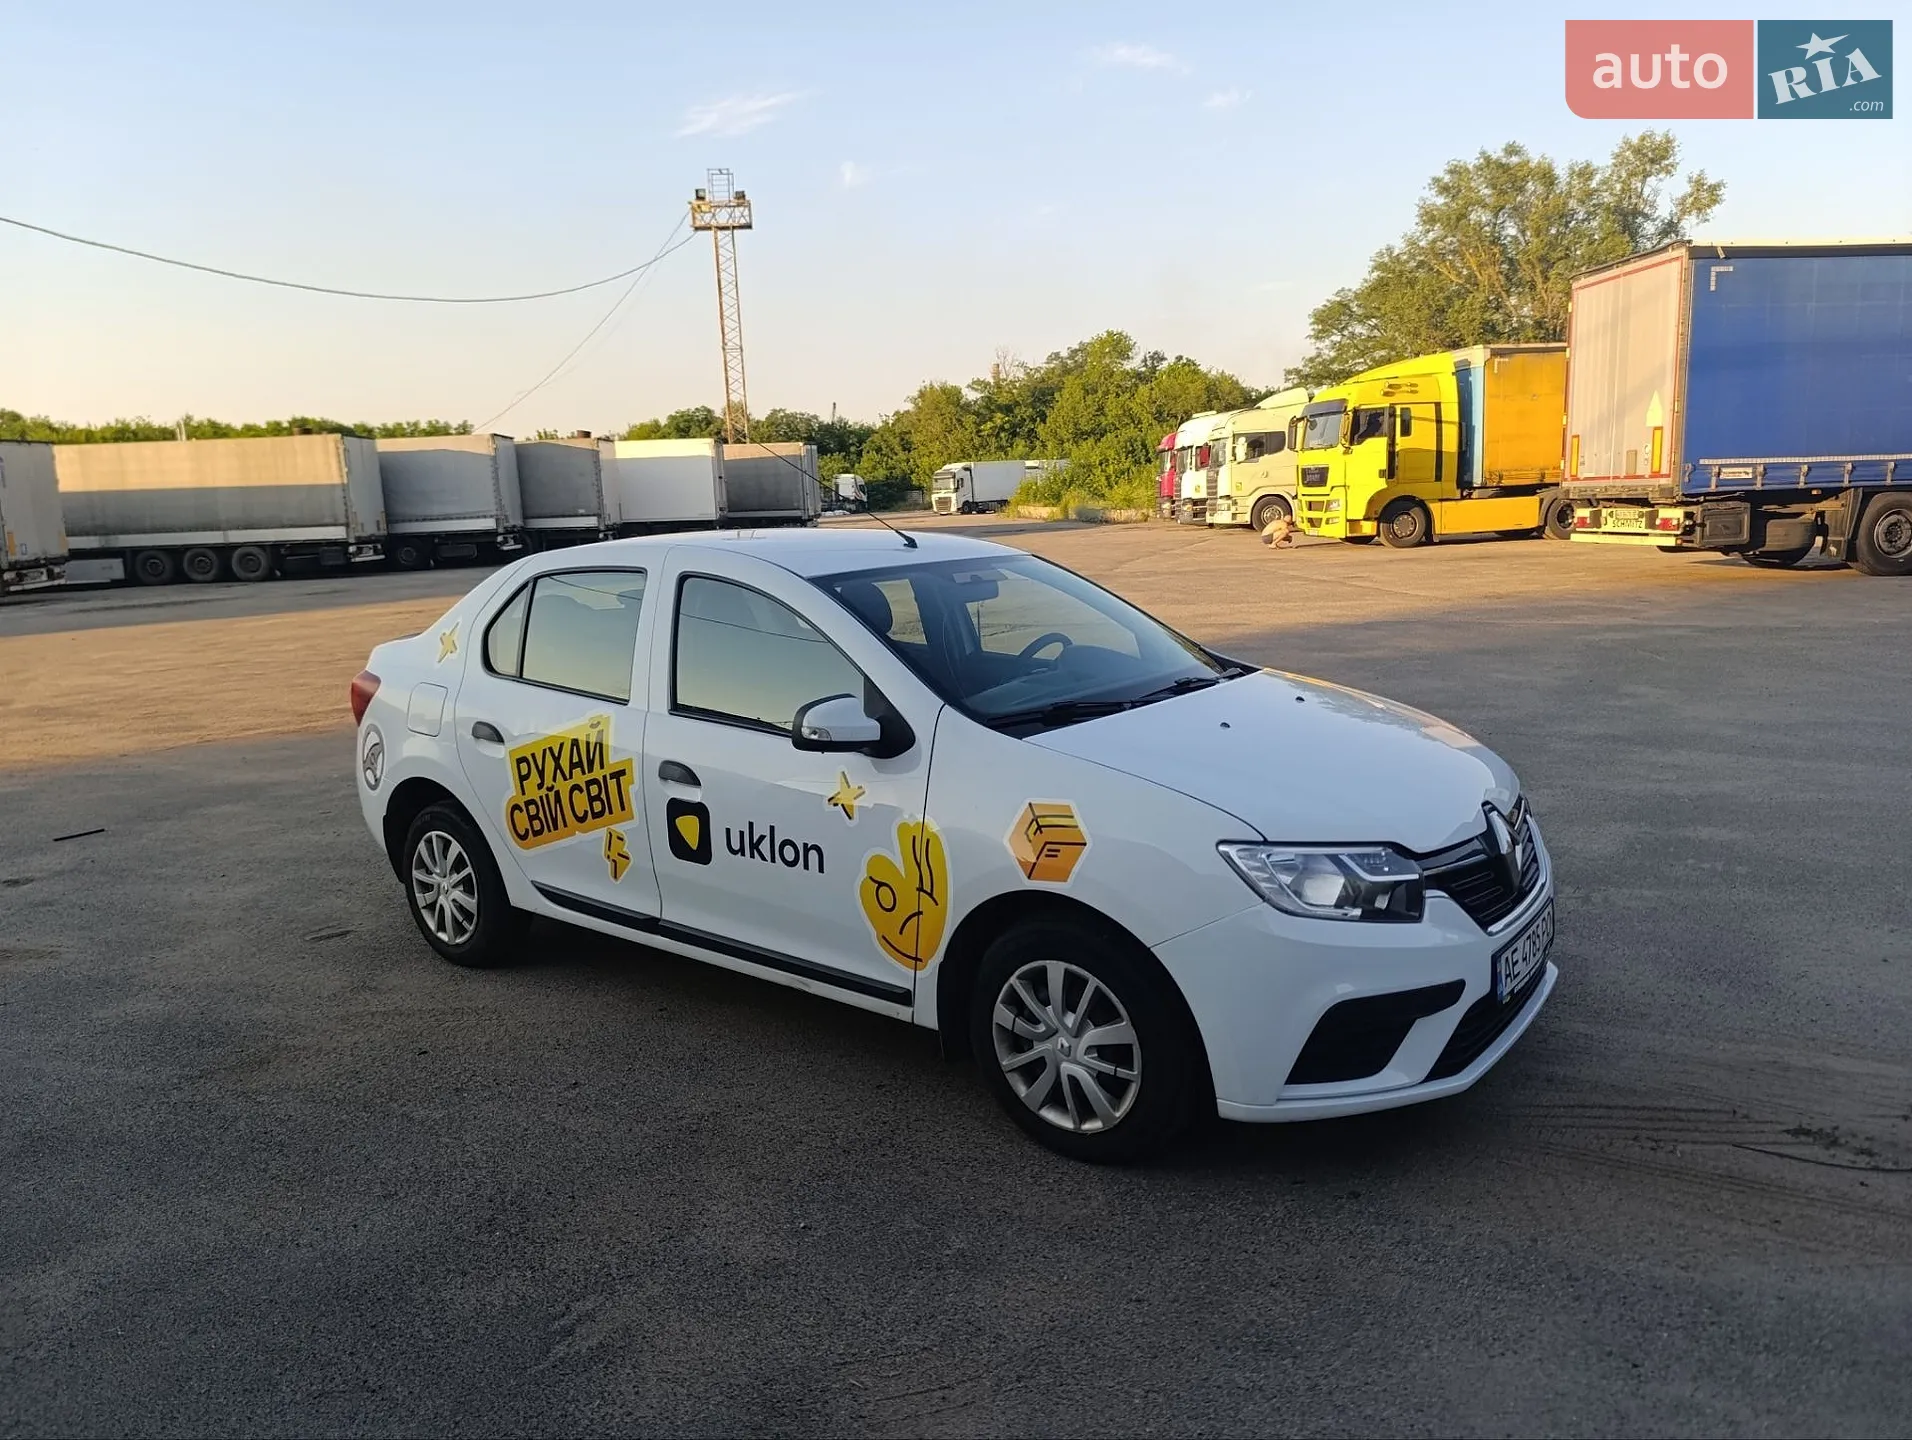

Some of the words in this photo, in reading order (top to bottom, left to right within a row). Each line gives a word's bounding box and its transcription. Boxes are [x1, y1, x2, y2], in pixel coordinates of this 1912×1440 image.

[515, 717, 606, 796] РУХАЙ
[509, 785, 568, 842] СВІЙ
[569, 768, 628, 825] СВІТ
[725, 820, 825, 874] uklon
[1504, 947, 1521, 988] AE
